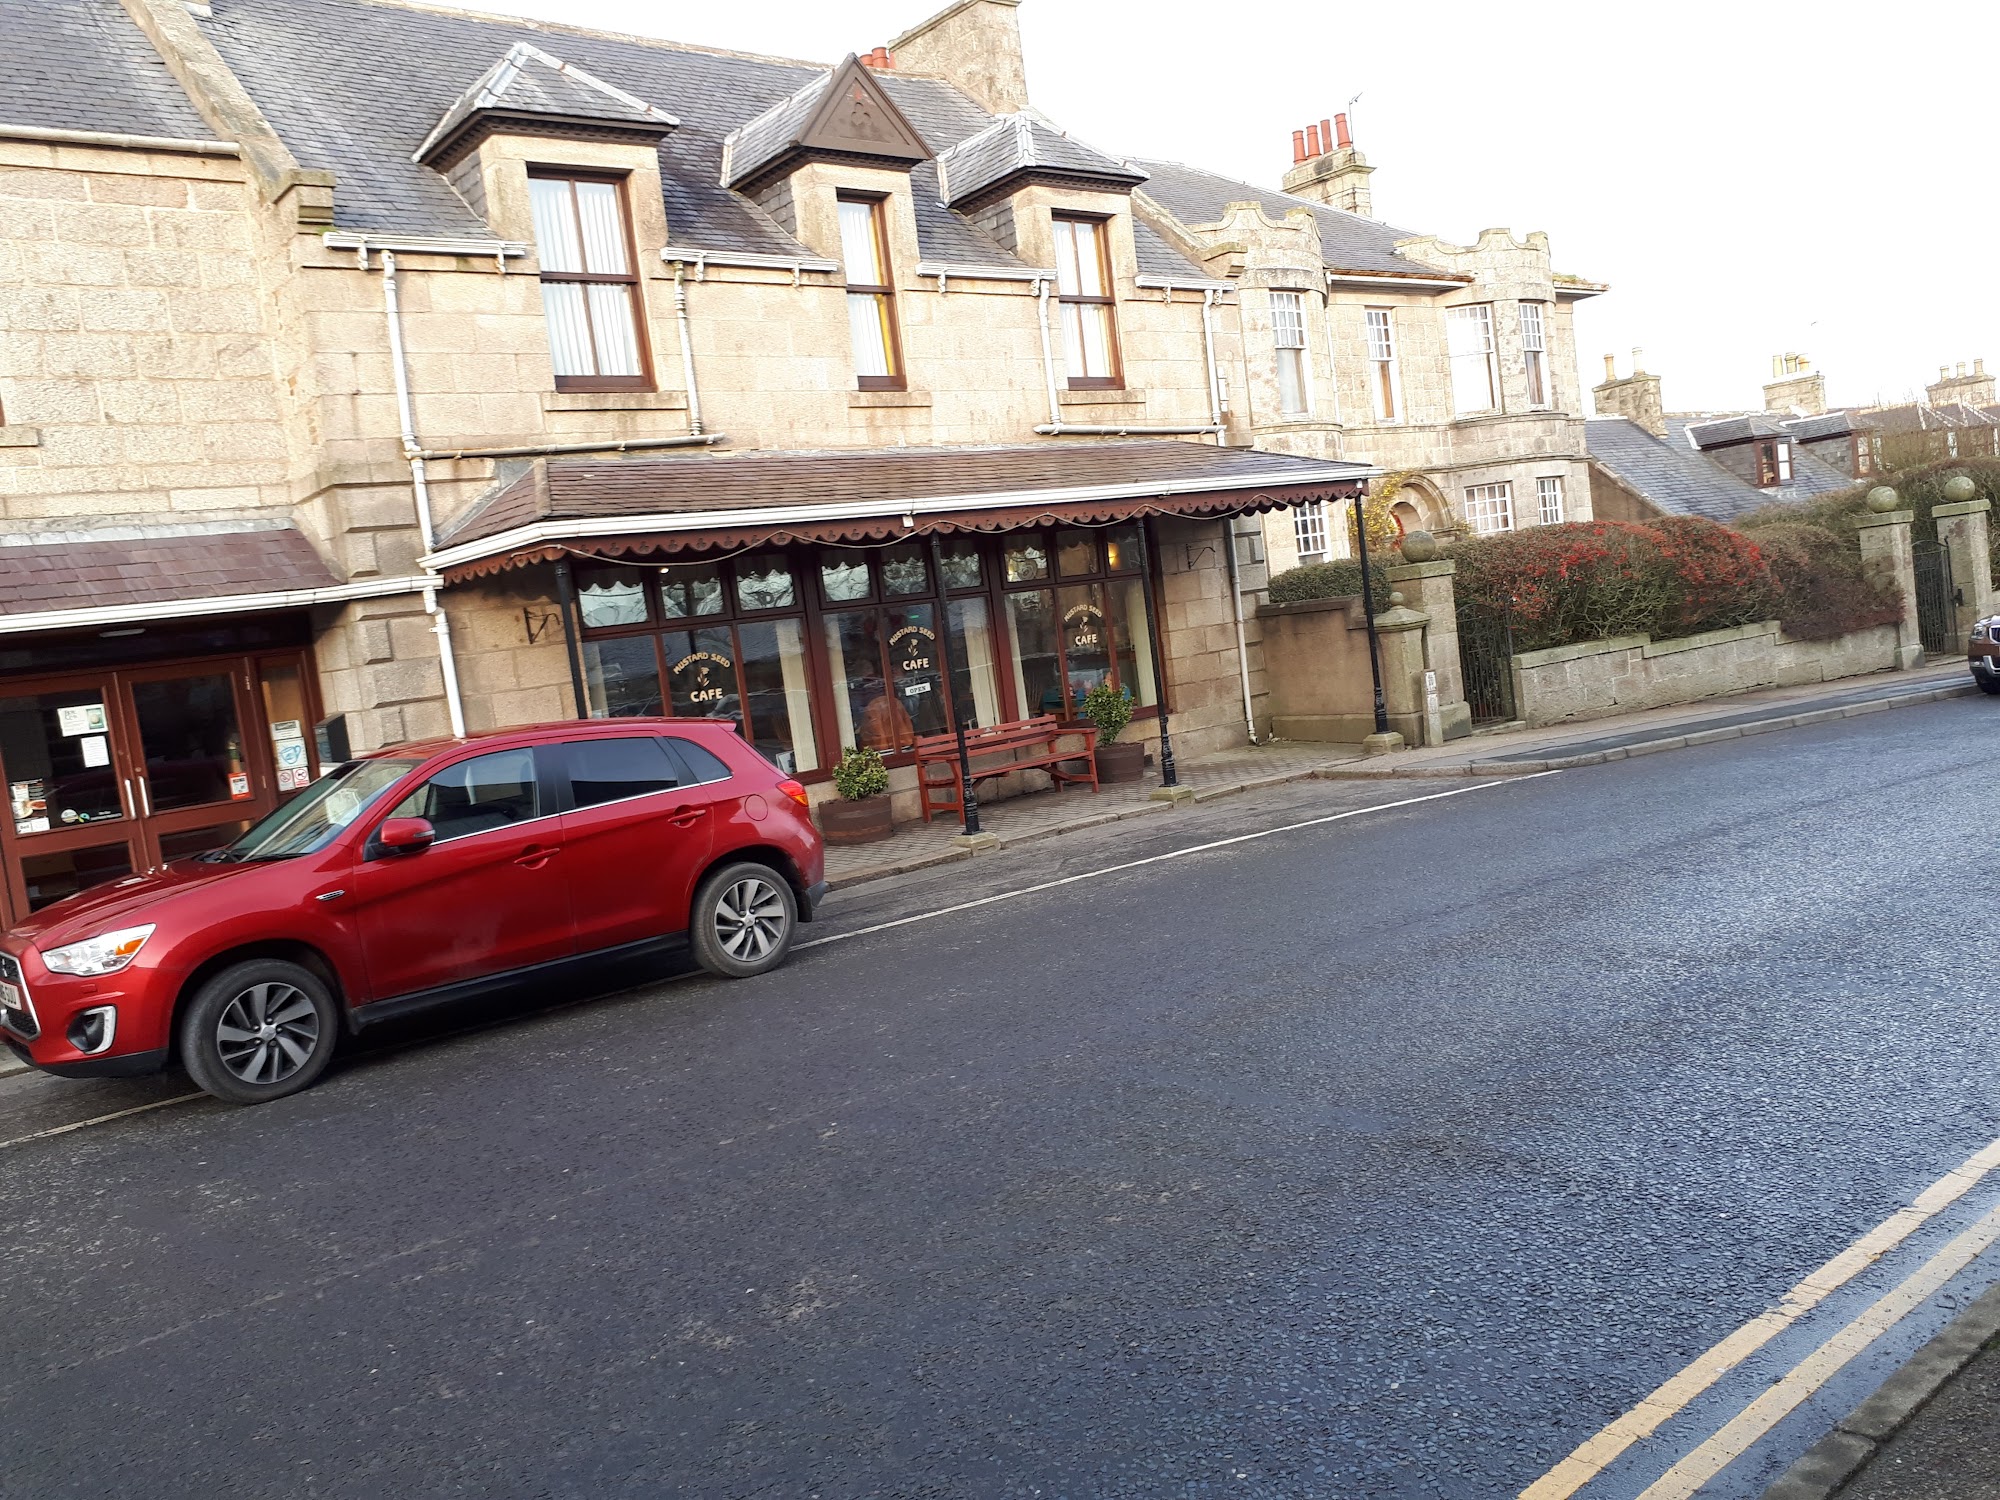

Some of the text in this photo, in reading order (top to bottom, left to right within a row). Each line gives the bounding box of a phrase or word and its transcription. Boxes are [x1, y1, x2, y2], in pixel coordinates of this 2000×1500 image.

[1063, 604, 1102, 622] MUSTARD SEED
[889, 626, 935, 646] MUSTARD SEED
[1075, 633, 1097, 645] CAFE
[673, 651, 731, 675] MUSTARD SEED
[902, 657, 930, 671] CAFE
[690, 687, 723, 703] CAFE
[909, 685, 926, 694] OPEN
